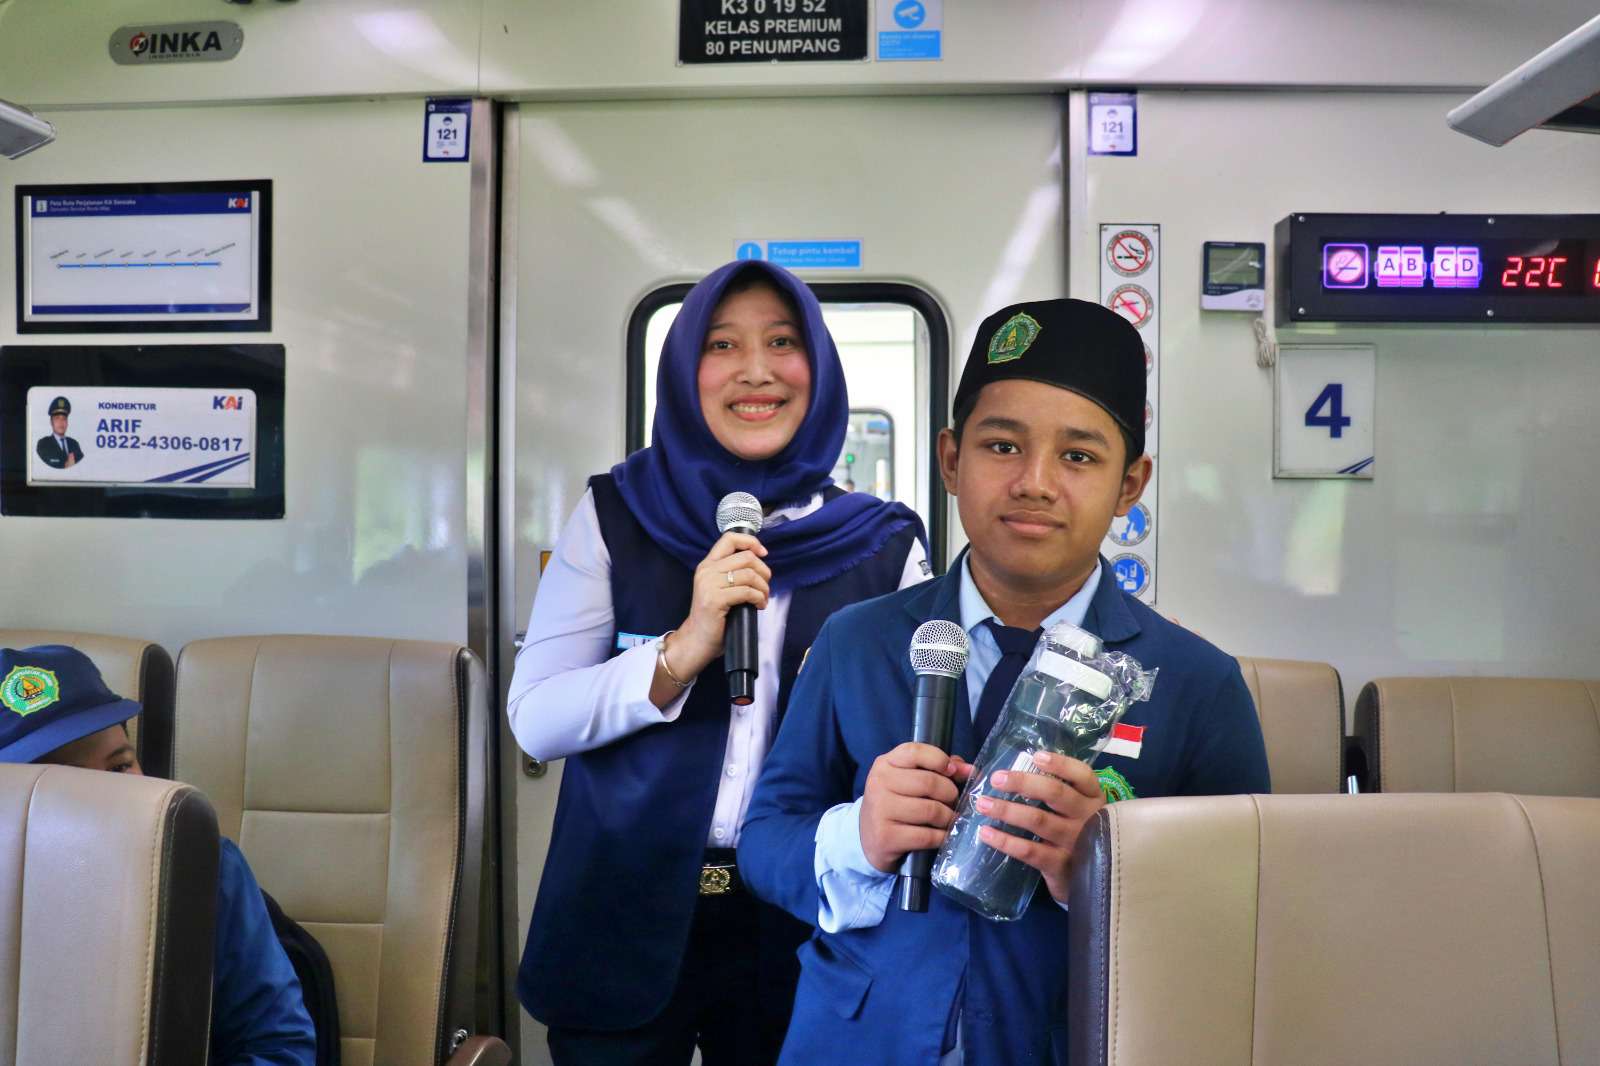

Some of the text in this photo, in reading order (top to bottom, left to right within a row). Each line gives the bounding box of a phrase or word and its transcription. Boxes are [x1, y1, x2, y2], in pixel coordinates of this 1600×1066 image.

[721, 0, 748, 14] K3
[774, 0, 796, 13] 19
[803, 0, 826, 12] 52
[705, 18, 842, 35] KELAS PREMIUM
[149, 31, 222, 53] INKA
[705, 38, 841, 55] 80 PENUMPANG
[1101, 121, 1123, 133] 121
[437, 129, 457, 140] 121
[1383, 258, 1473, 272] A B C D
[98, 402, 157, 411] KONDEKTUR
[1305, 383, 1351, 438] 4
[97, 419, 142, 433] ARIF
[96, 435, 243, 451] 0822-4306-0817
